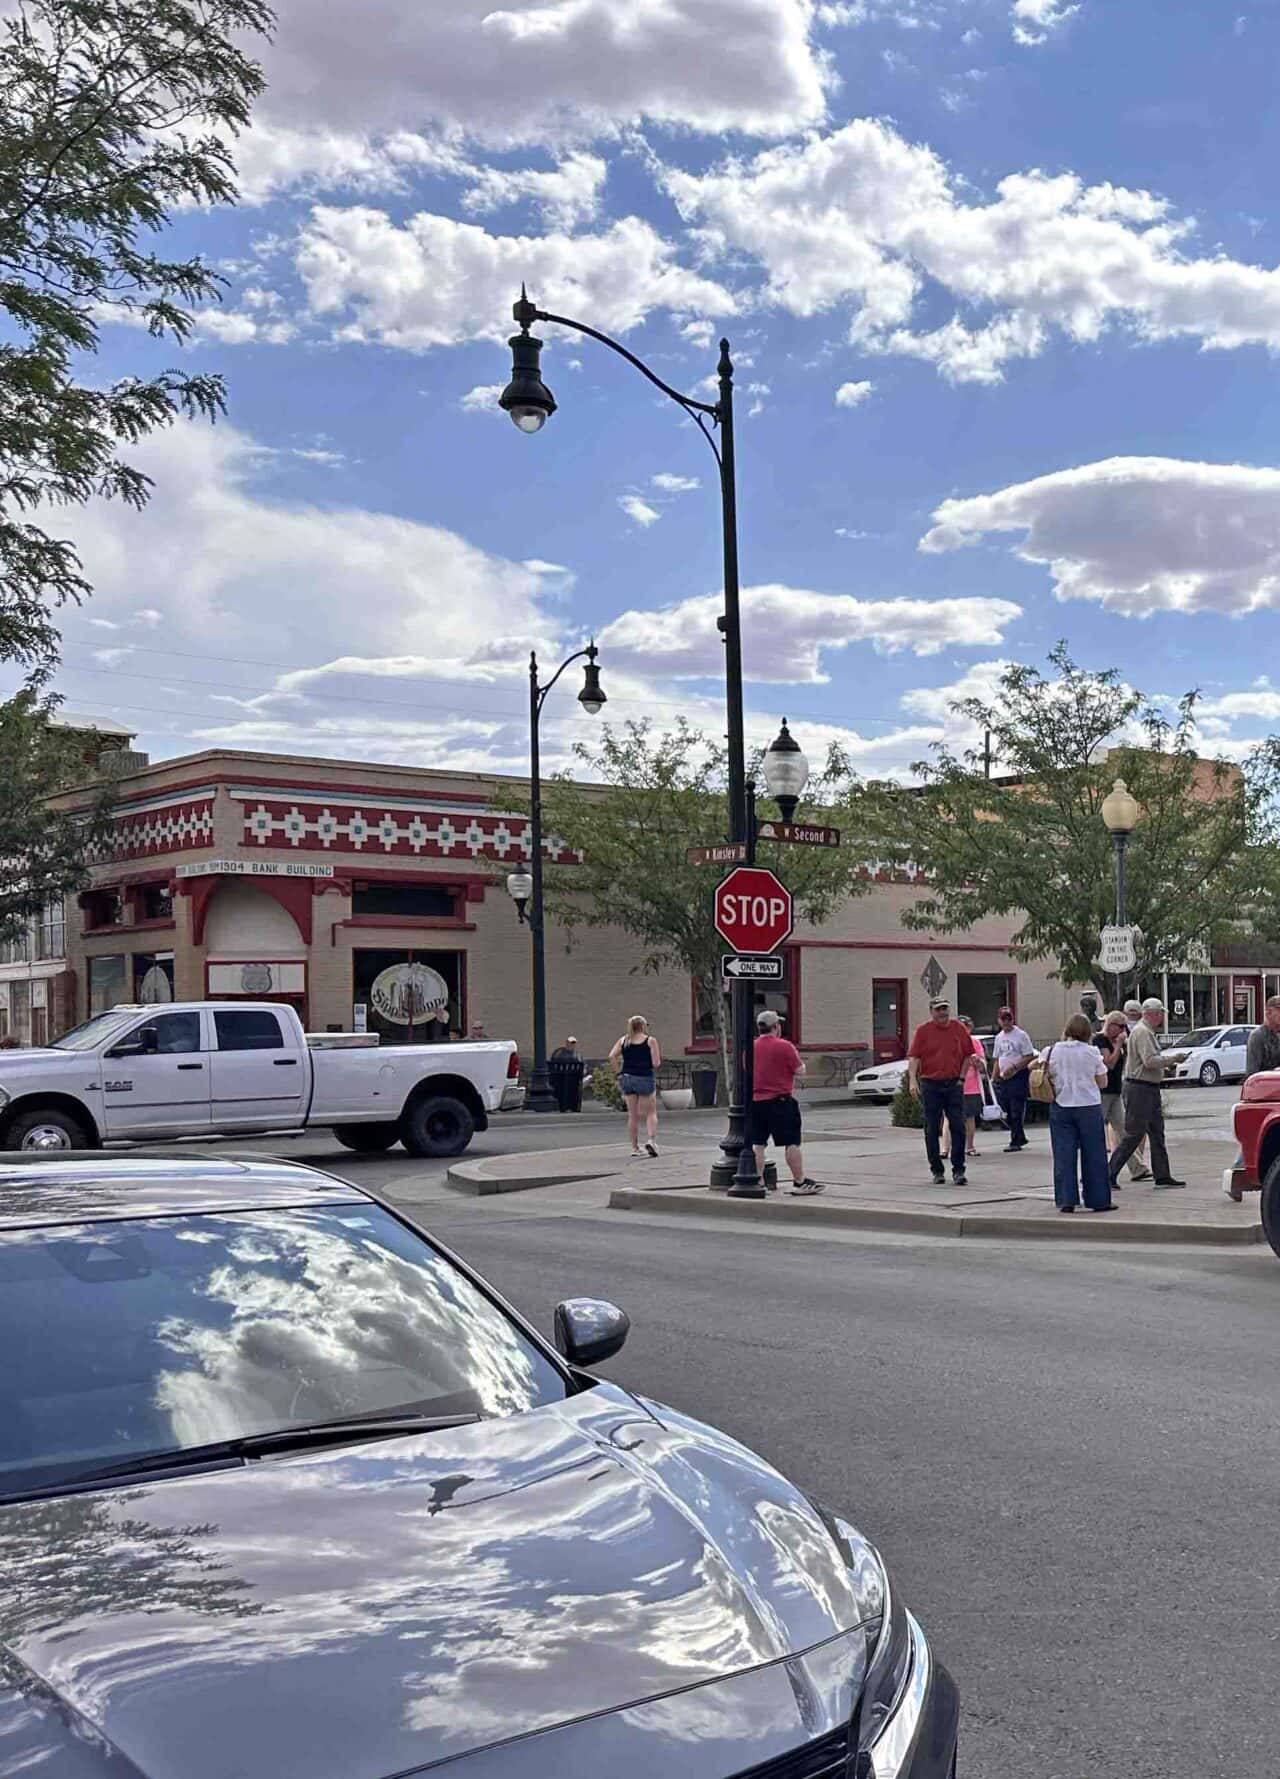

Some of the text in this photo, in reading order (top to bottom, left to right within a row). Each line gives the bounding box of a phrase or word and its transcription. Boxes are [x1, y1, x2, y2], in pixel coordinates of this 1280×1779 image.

[794, 827, 825, 843] Second
[712, 846, 736, 861] Kinsley
[220, 862, 244, 873] 1904
[252, 862, 278, 874] BANK
[286, 864, 332, 876] BUILDING
[721, 894, 785, 928] STOP
[740, 963, 776, 973] ONE WAY
